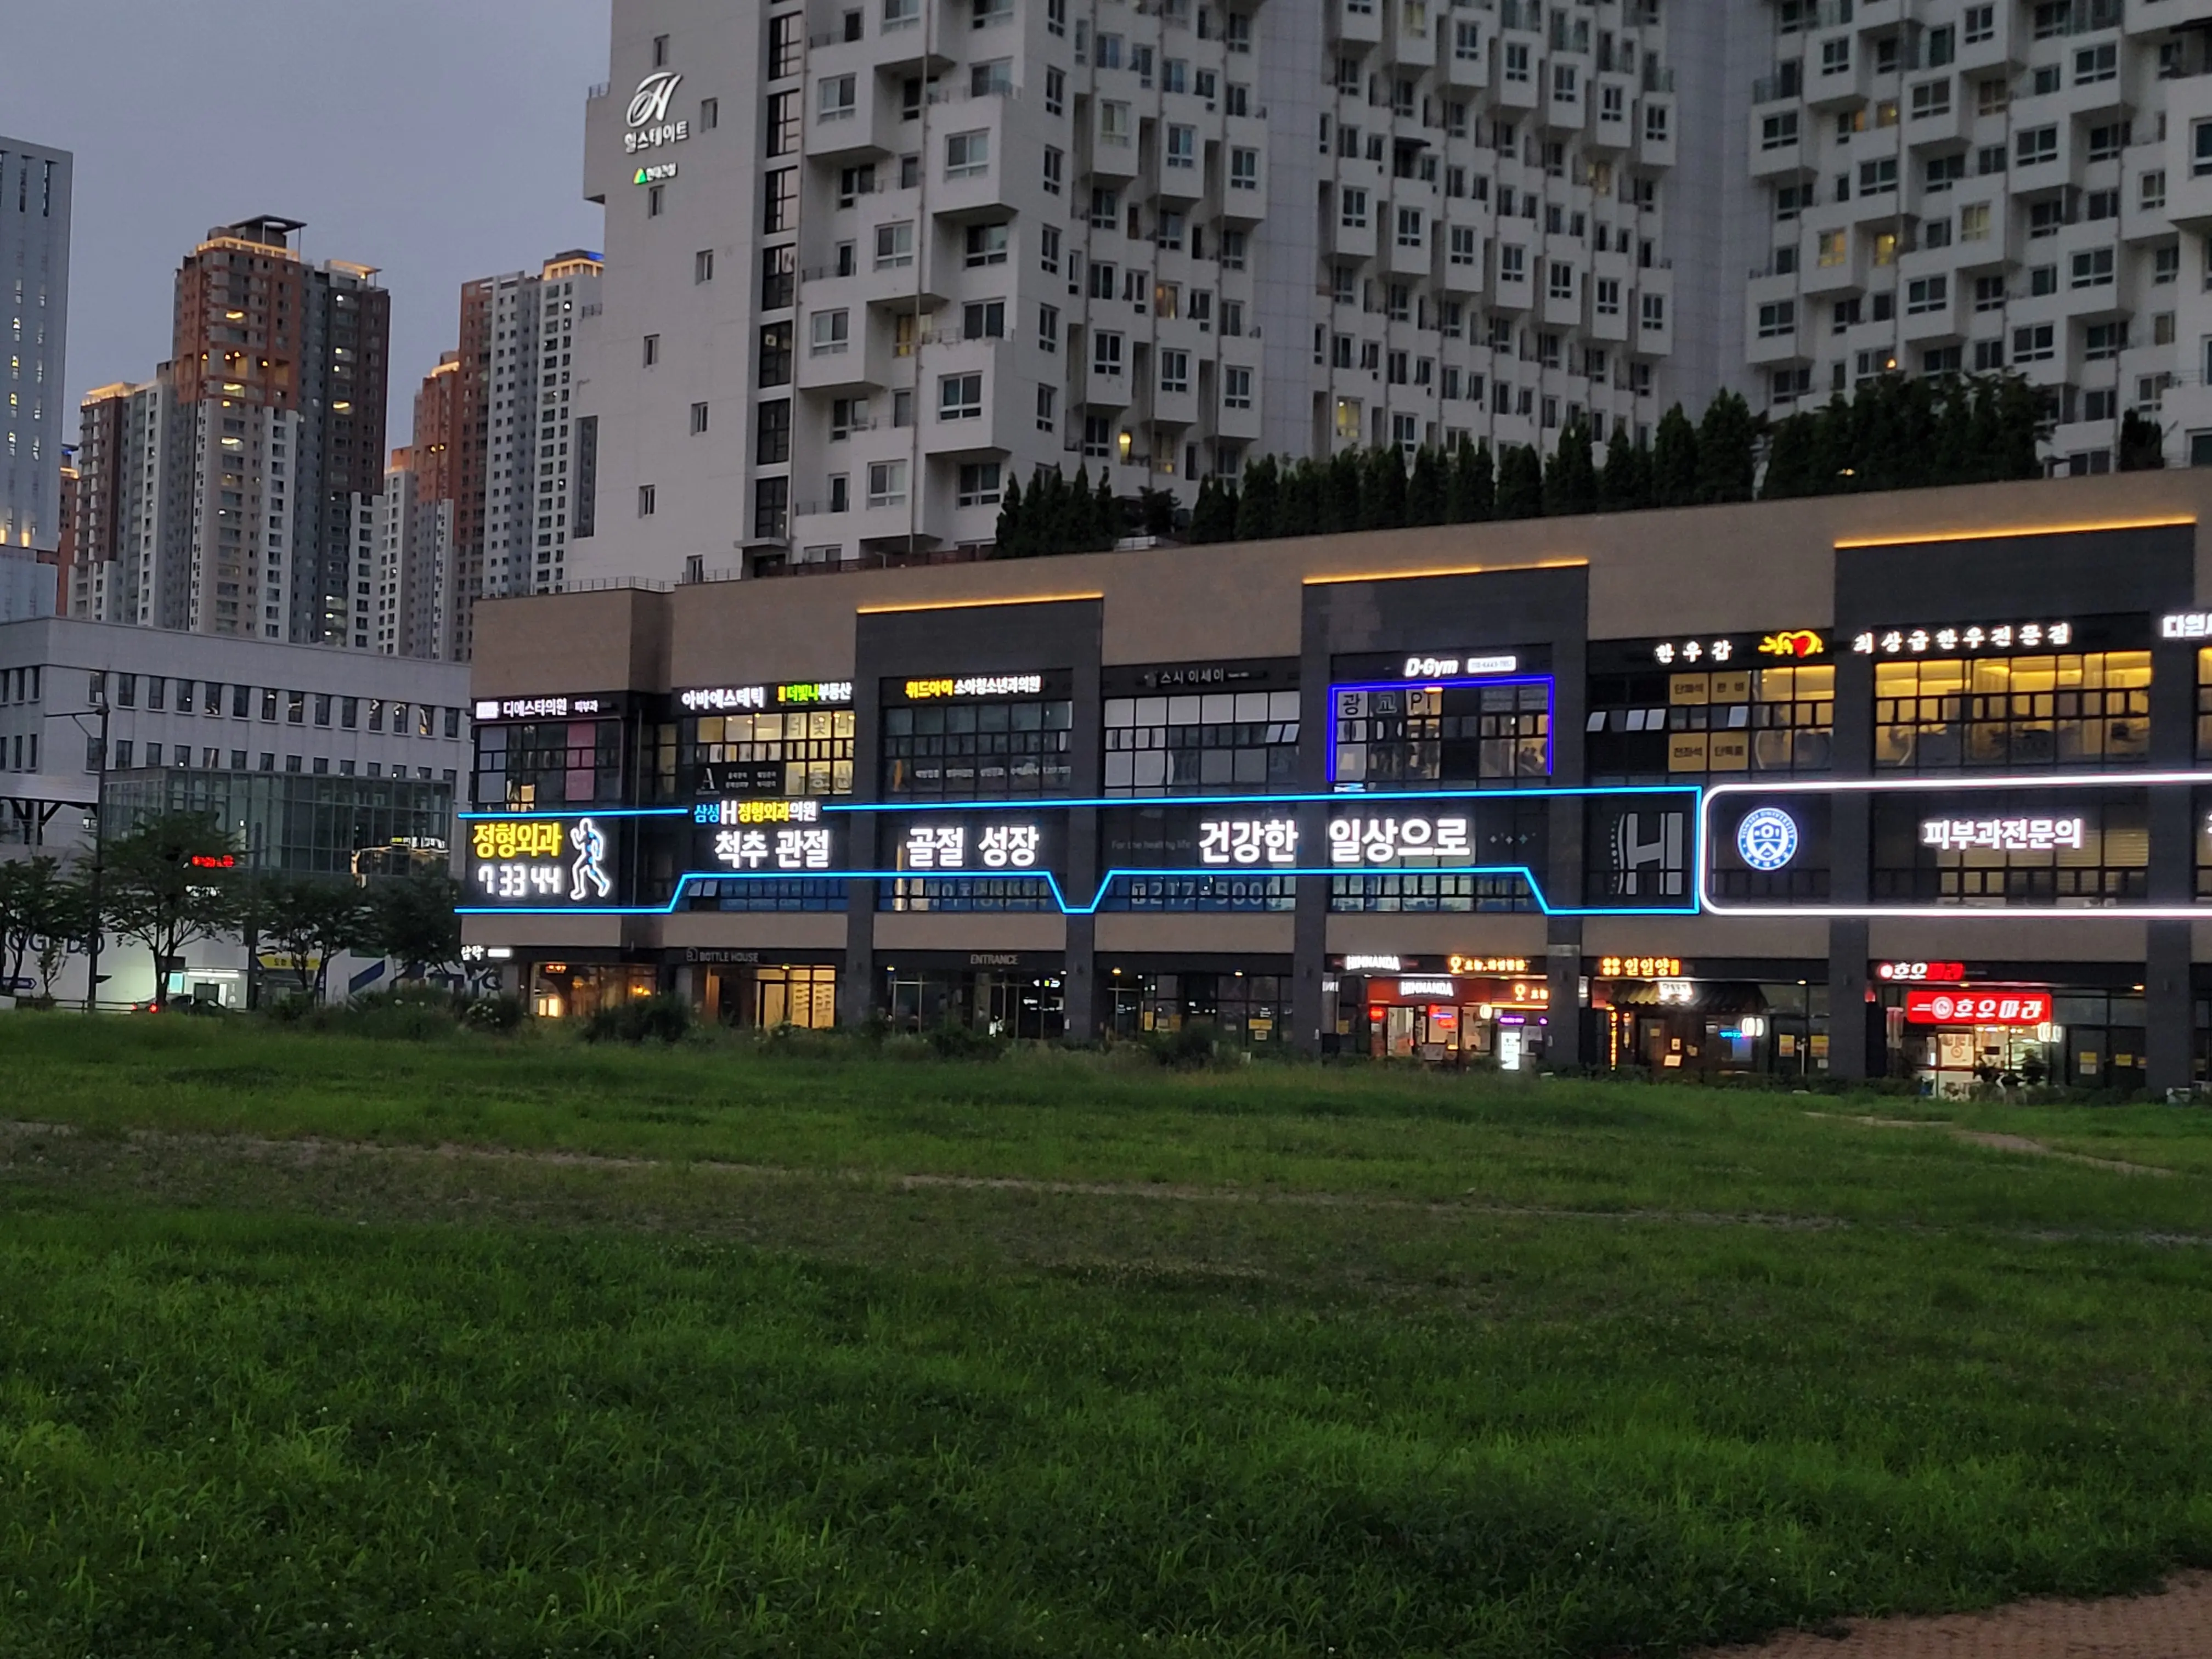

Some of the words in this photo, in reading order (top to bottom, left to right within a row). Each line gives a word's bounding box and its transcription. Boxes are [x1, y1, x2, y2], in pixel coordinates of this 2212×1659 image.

[624, 120, 690, 154] 힐스테이트
[1160, 671, 1184, 684] 스시
[1188, 668, 1224, 682] 이세이
[503, 697, 567, 718] 디에스타의원
[681, 686, 765, 710] 아바에스테틱
[473, 822, 563, 859] 정형외과
[714, 830, 769, 869] 척추
[775, 830, 830, 868] 관절
[906, 827, 964, 867] 골절
[978, 826, 1040, 867] 성장
[1199, 820, 1300, 864] 건강한
[1329, 818, 1471, 863] 일상으로
[1923, 818, 2084, 850] 피부과전문의
[699, 951, 730, 962] BOTTLE
[731, 952, 759, 963] HOUSE
[970, 954, 1019, 966] ENTRANCE
